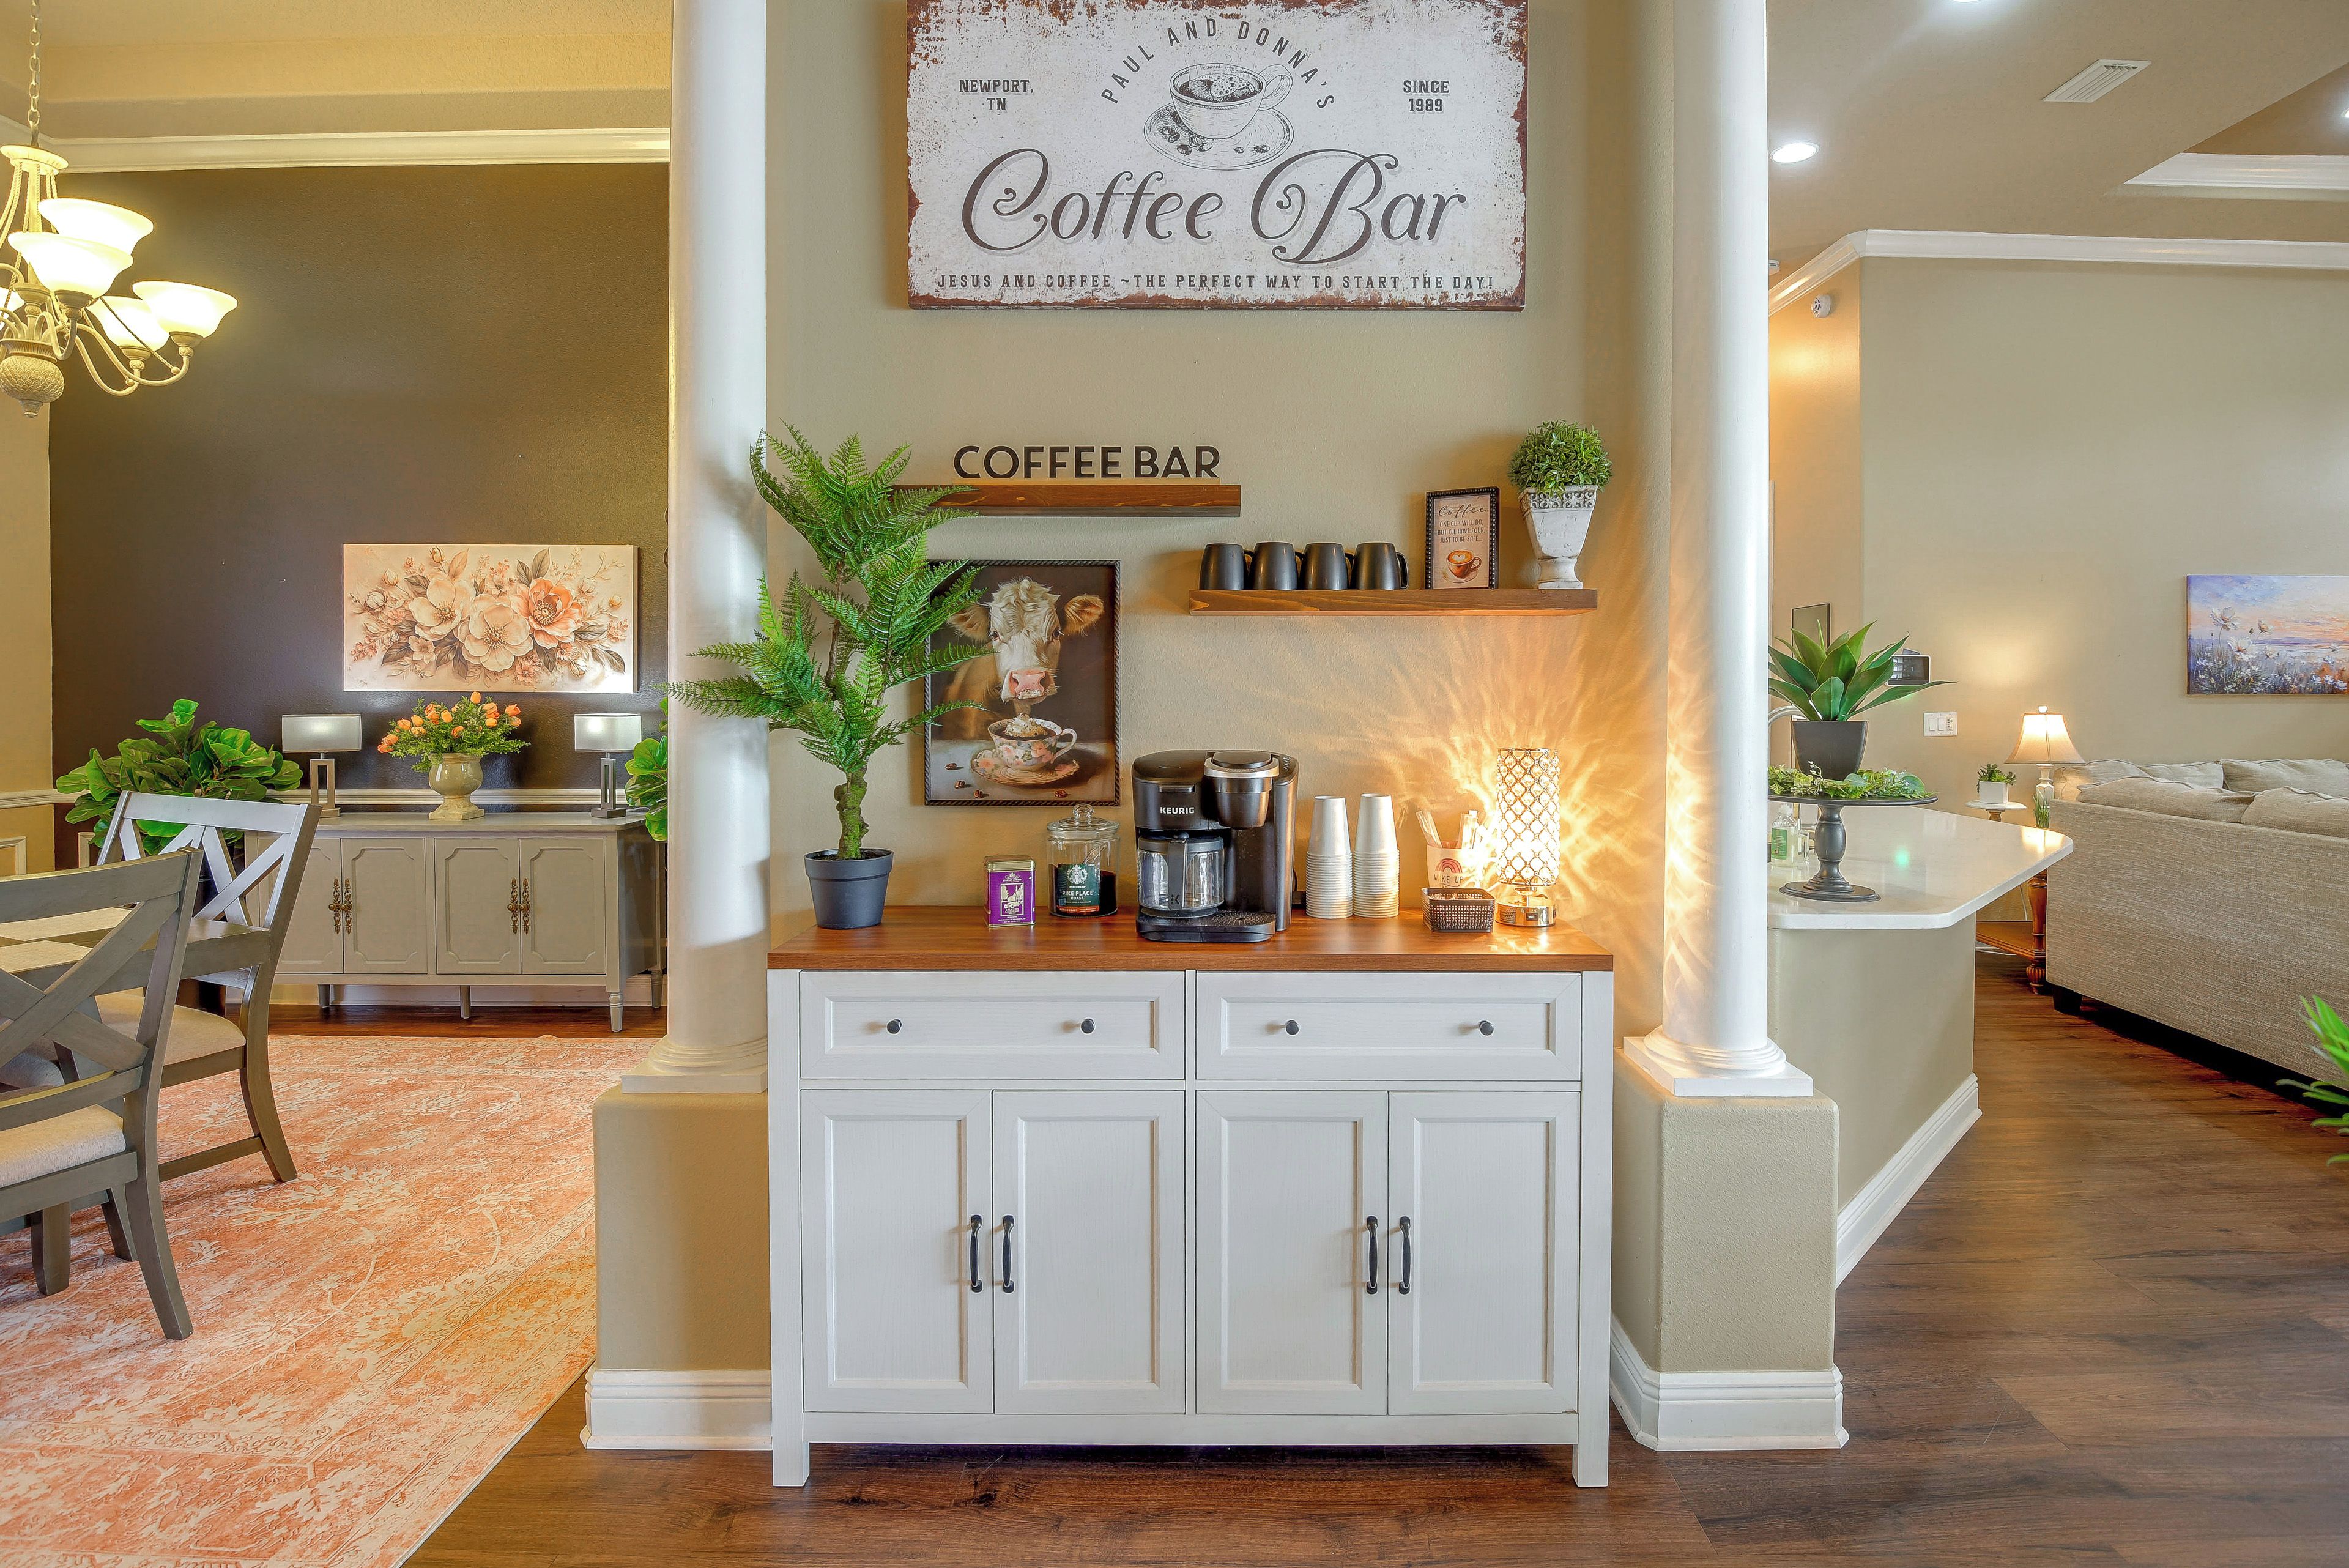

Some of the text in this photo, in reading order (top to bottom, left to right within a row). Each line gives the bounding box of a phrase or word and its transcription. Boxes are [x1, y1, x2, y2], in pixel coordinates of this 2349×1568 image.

[1100, 18, 1335, 109] PAUL AND DONNA'S
[959, 79, 1034, 94] NEWPORT,
[1403, 80, 1449, 94] SINCE
[986, 97, 1007, 111] TN
[1408, 98, 1444, 112] 1989
[962, 147, 1467, 264] Coffee Bar
[938, 274, 992, 288] JESUS
[1001, 274, 1036, 288] AND
[1046, 274, 1111, 288] COFFEE
[1176, 275, 1255, 288] PERFECT
[1265, 275, 1302, 288] WAY
[1312, 275, 1333, 288] TO
[1343, 275, 1400, 288] START
[1409, 275, 1443, 289] THE
[1453, 275, 1493, 289] DAY!
[953, 445, 1221, 479] COFFEE BAR
[1438, 503, 1488, 518] Coffee
[1433, 873, 1450, 883] WKE
